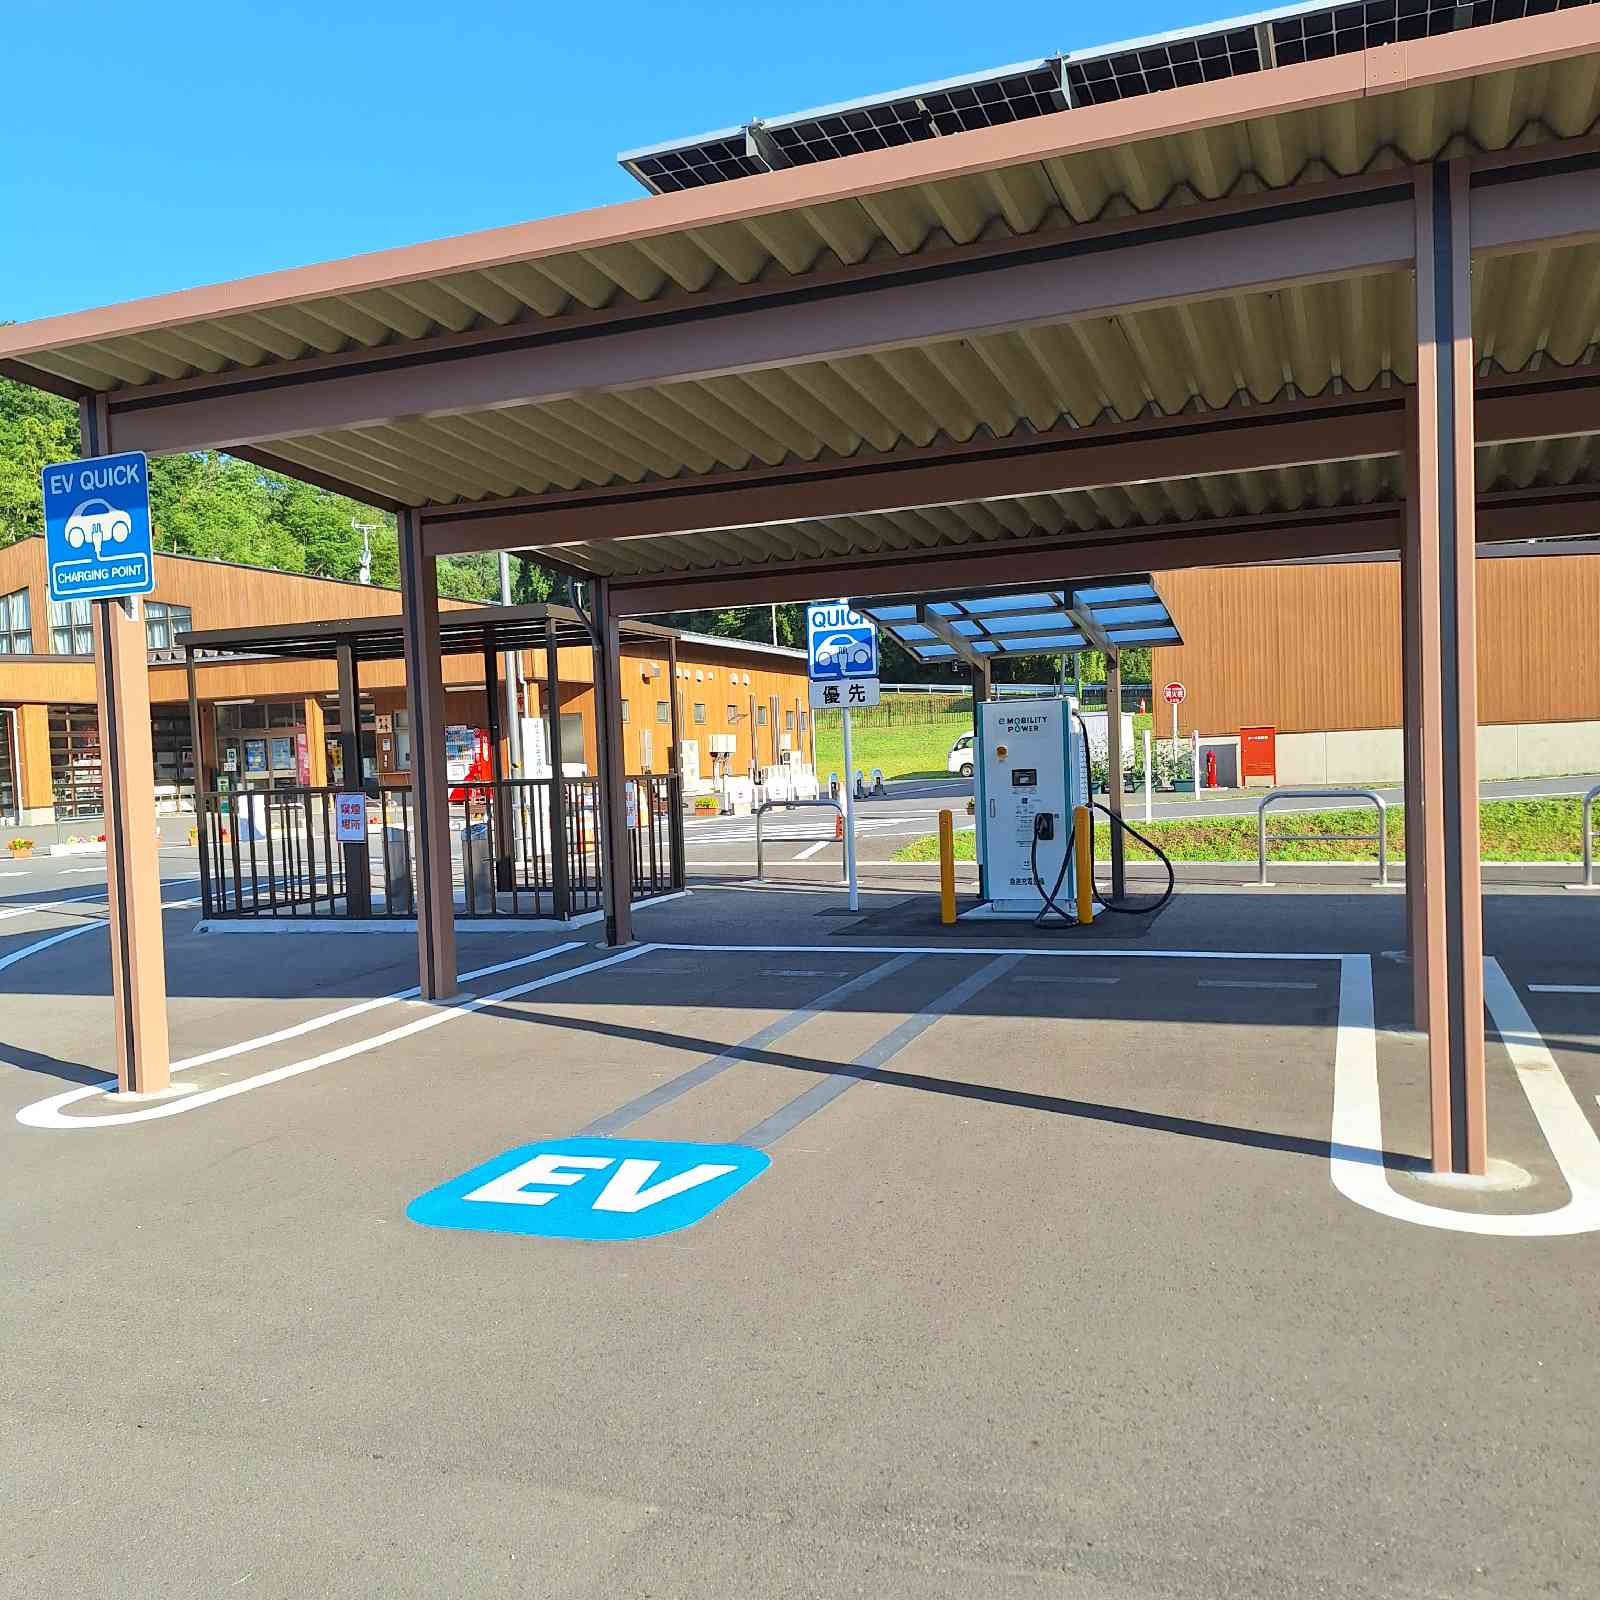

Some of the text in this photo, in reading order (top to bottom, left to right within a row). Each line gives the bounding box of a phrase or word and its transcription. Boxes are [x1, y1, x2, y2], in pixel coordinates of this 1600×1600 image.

[50, 464, 139, 494] EV QUICK
[57, 564, 143, 584] CHARGING POINT
[823, 683, 866, 704] 優先
[1007, 716, 1048, 725] MOBILITY
[1007, 725, 1039, 733] POWER
[461, 1153, 739, 1213] EV
